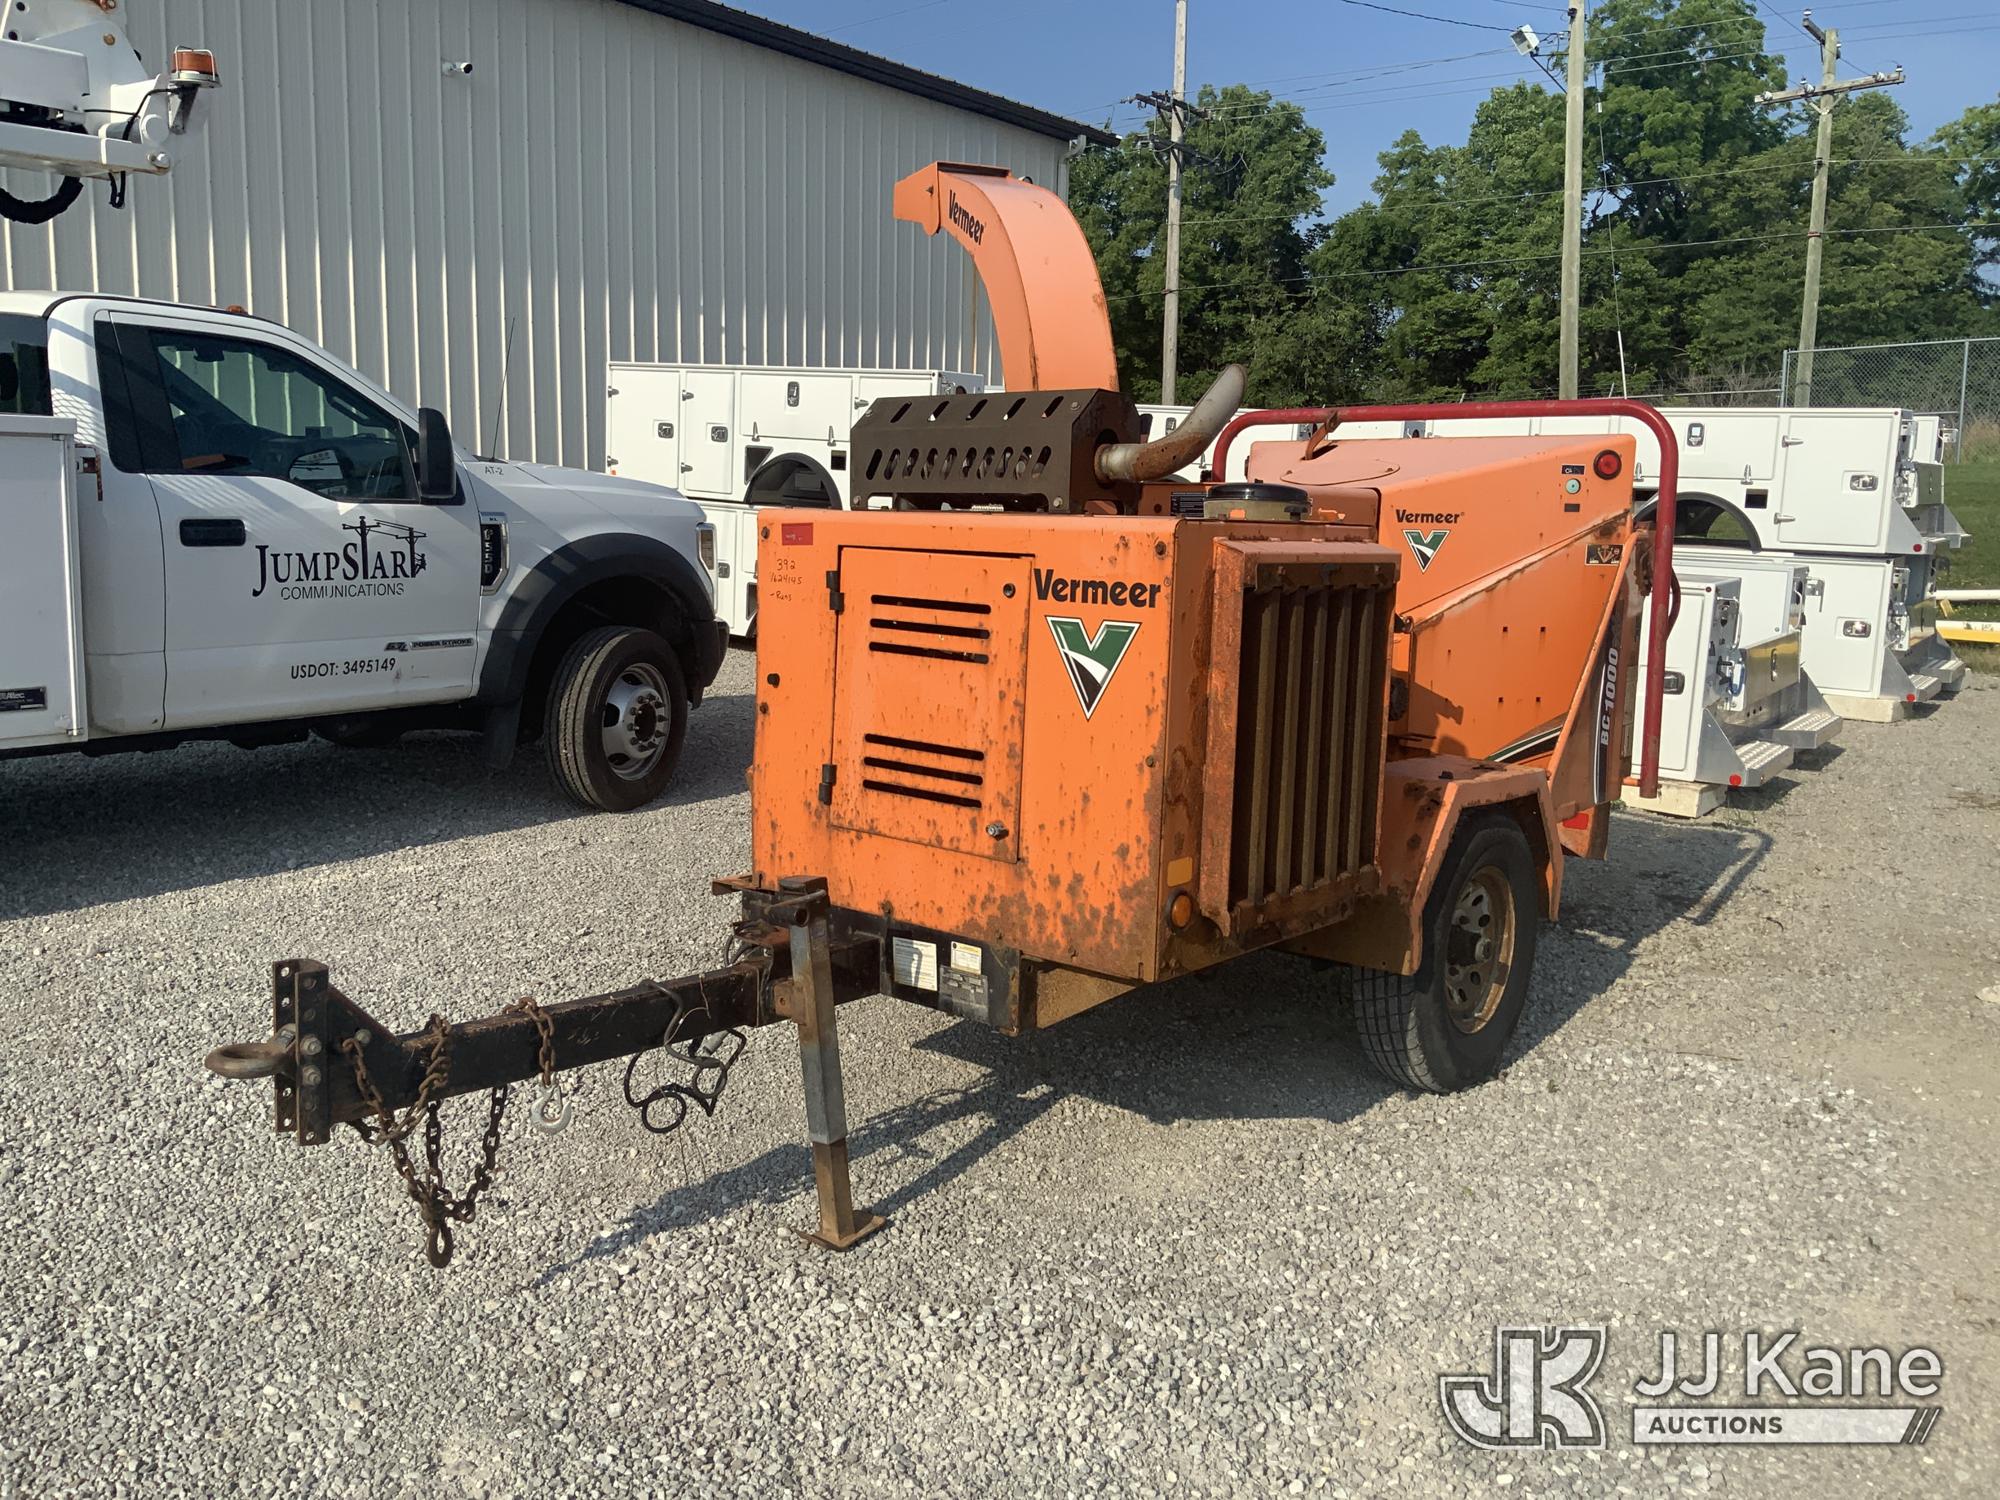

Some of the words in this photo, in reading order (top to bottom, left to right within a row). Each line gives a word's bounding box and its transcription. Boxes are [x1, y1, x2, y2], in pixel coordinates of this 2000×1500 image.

[949, 189, 985, 245] Vermeer
[485, 466, 503, 475] AT-2
[1396, 509, 1460, 524] Vermeer
[280, 583, 405, 600] COMMUNICATIONS
[1033, 567, 1161, 609] Vermeer
[291, 662, 339, 679] USDOT:
[342, 657, 396, 675] 3495149
